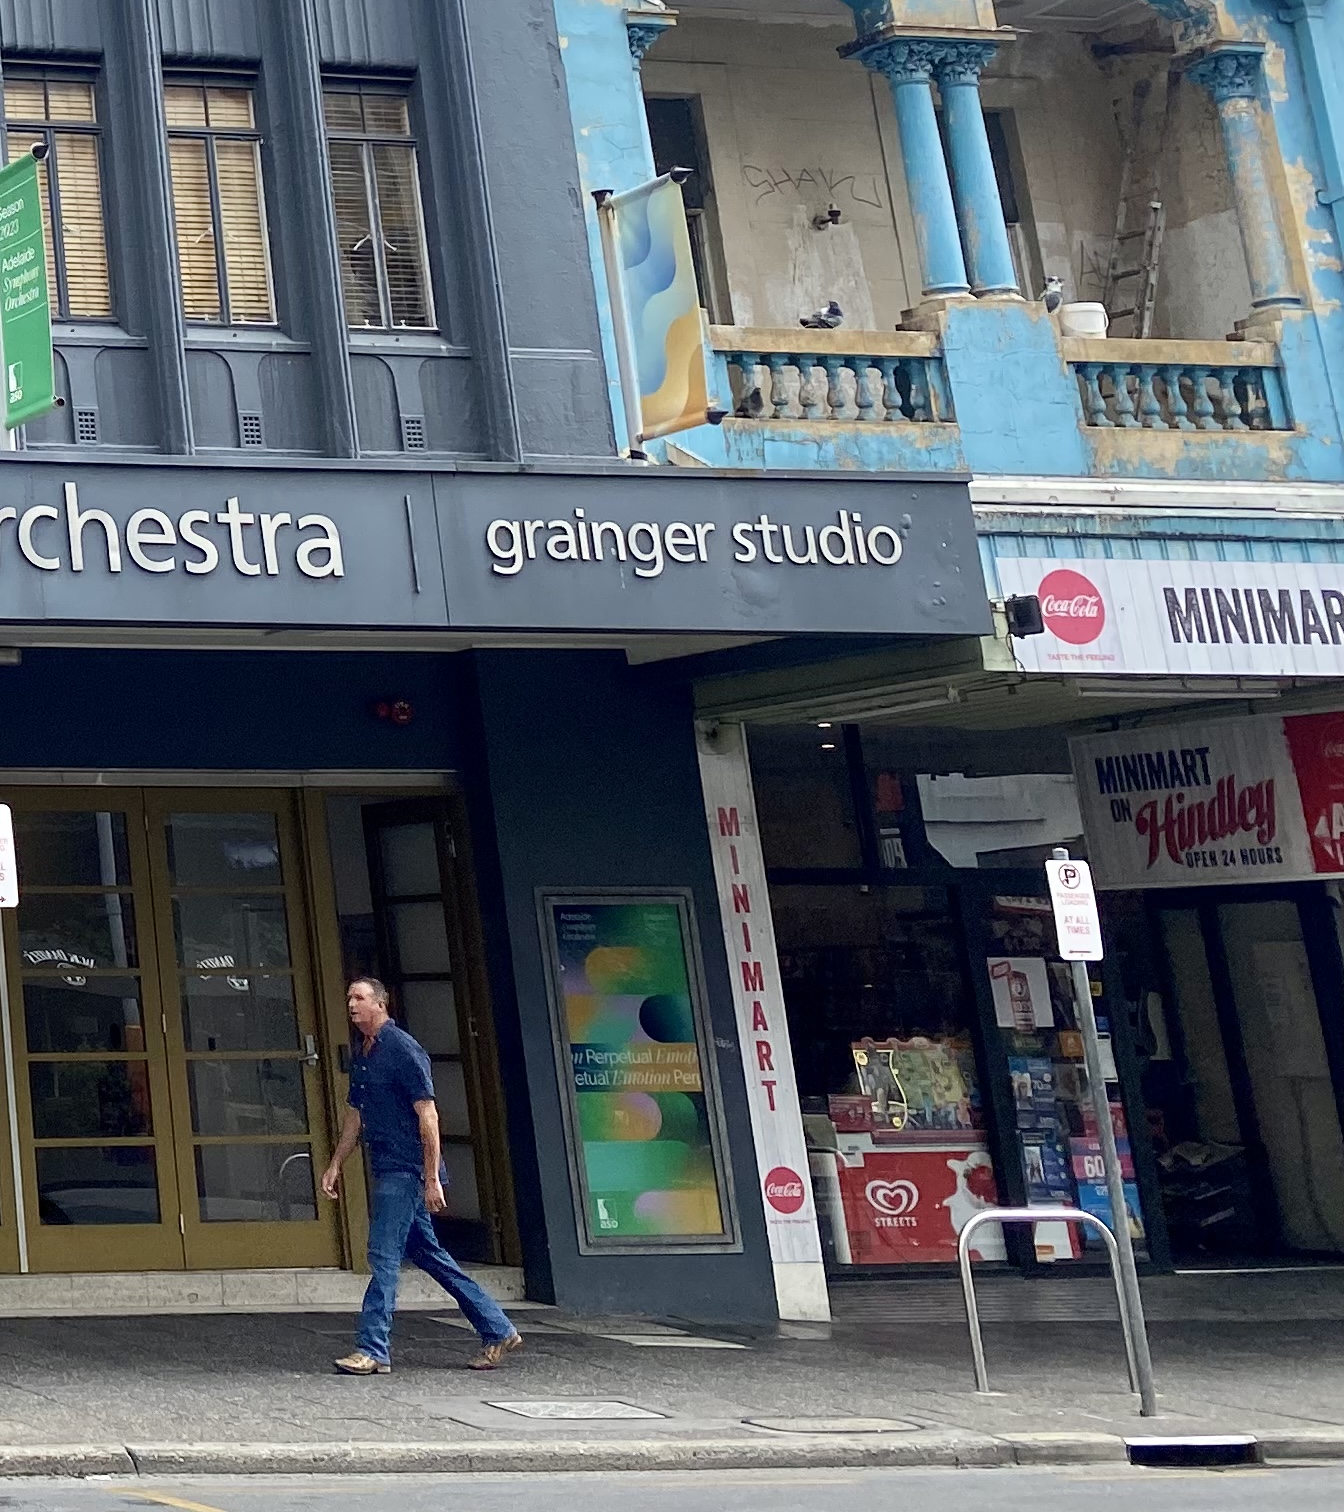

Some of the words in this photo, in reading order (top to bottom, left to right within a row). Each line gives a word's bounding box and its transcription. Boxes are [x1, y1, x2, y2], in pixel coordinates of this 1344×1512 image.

[0, 218, 20, 241] 2023
[1, 246, 35, 273] Adelaide
[486, 507, 716, 578] grainger
[732, 509, 904, 566] studio
[1094, 746, 1211, 794] MINIMART
[1111, 798, 1132, 822] ON
[1135, 774, 1276, 870] Hindley
[1185, 849, 1218, 869] OPEN
[1221, 849, 1236, 866] 24
[1239, 847, 1283, 866] HOURS
[1064, 916, 1073, 924] AT
[1075, 916, 1089, 924] ALL
[1066, 926, 1090, 934] TIMES
[717, 807, 777, 1111] MINIMART
[585, 1049, 652, 1066] Perpetual
[612, 1069, 670, 1085] Emotion
[1084, 1155, 1105, 1177] 60
[600, 1219, 618, 1228] aso
[874, 1216, 917, 1226] STREETS
